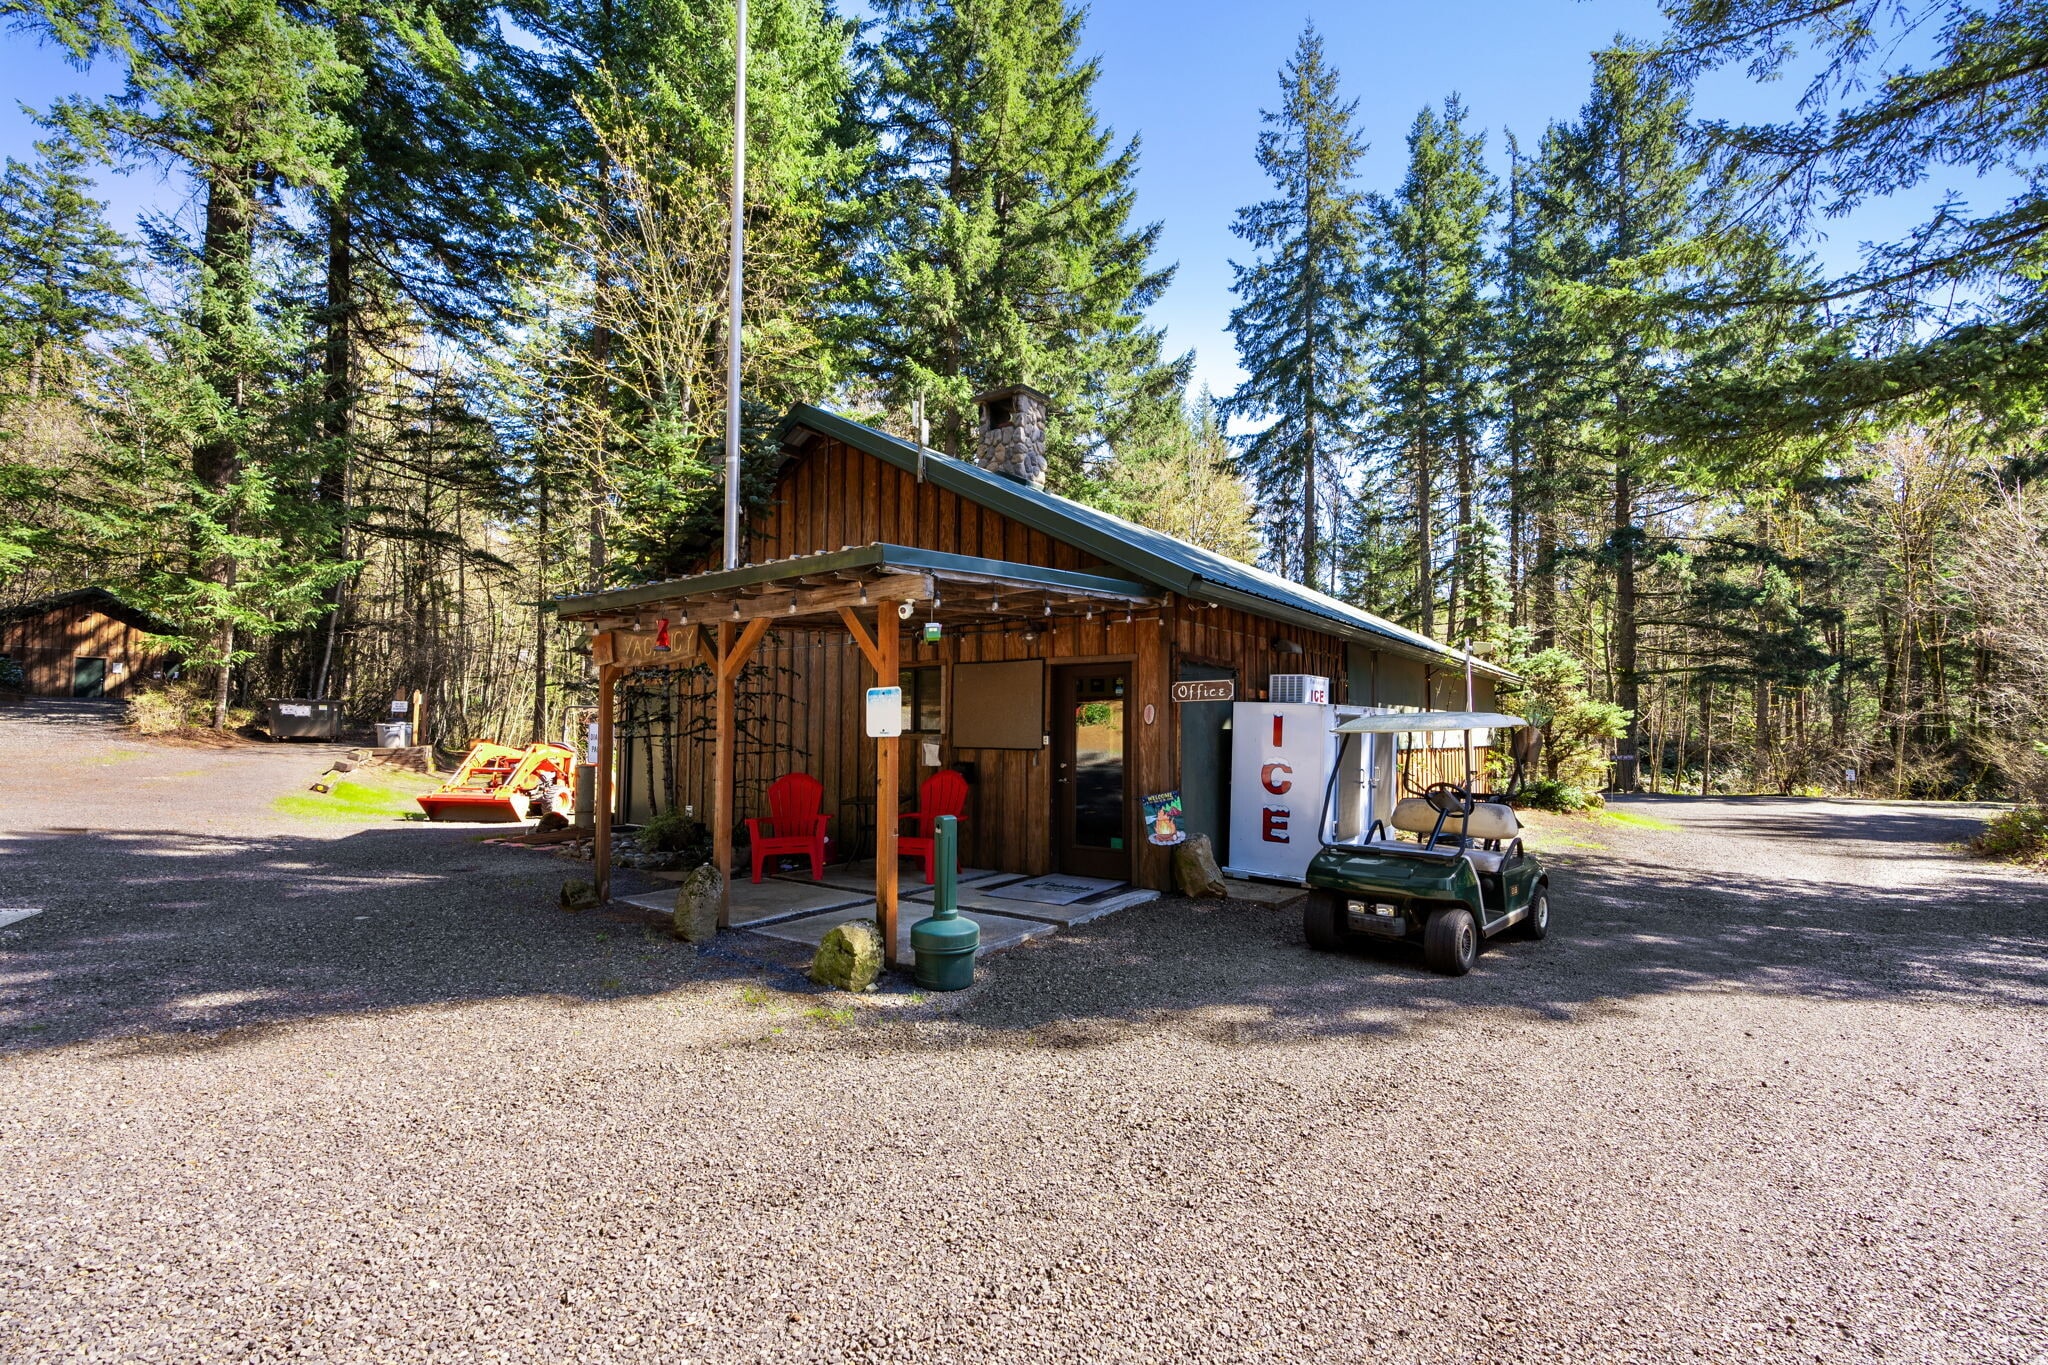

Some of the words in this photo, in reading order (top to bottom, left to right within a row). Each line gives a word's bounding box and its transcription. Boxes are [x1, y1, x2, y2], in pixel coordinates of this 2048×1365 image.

[623, 629, 694, 657] VACCY
[1178, 684, 1226, 700] Office
[1310, 689, 1325, 703] ICE
[1261, 711, 1293, 844] ICE
[1147, 791, 1173, 802] WELCOME
